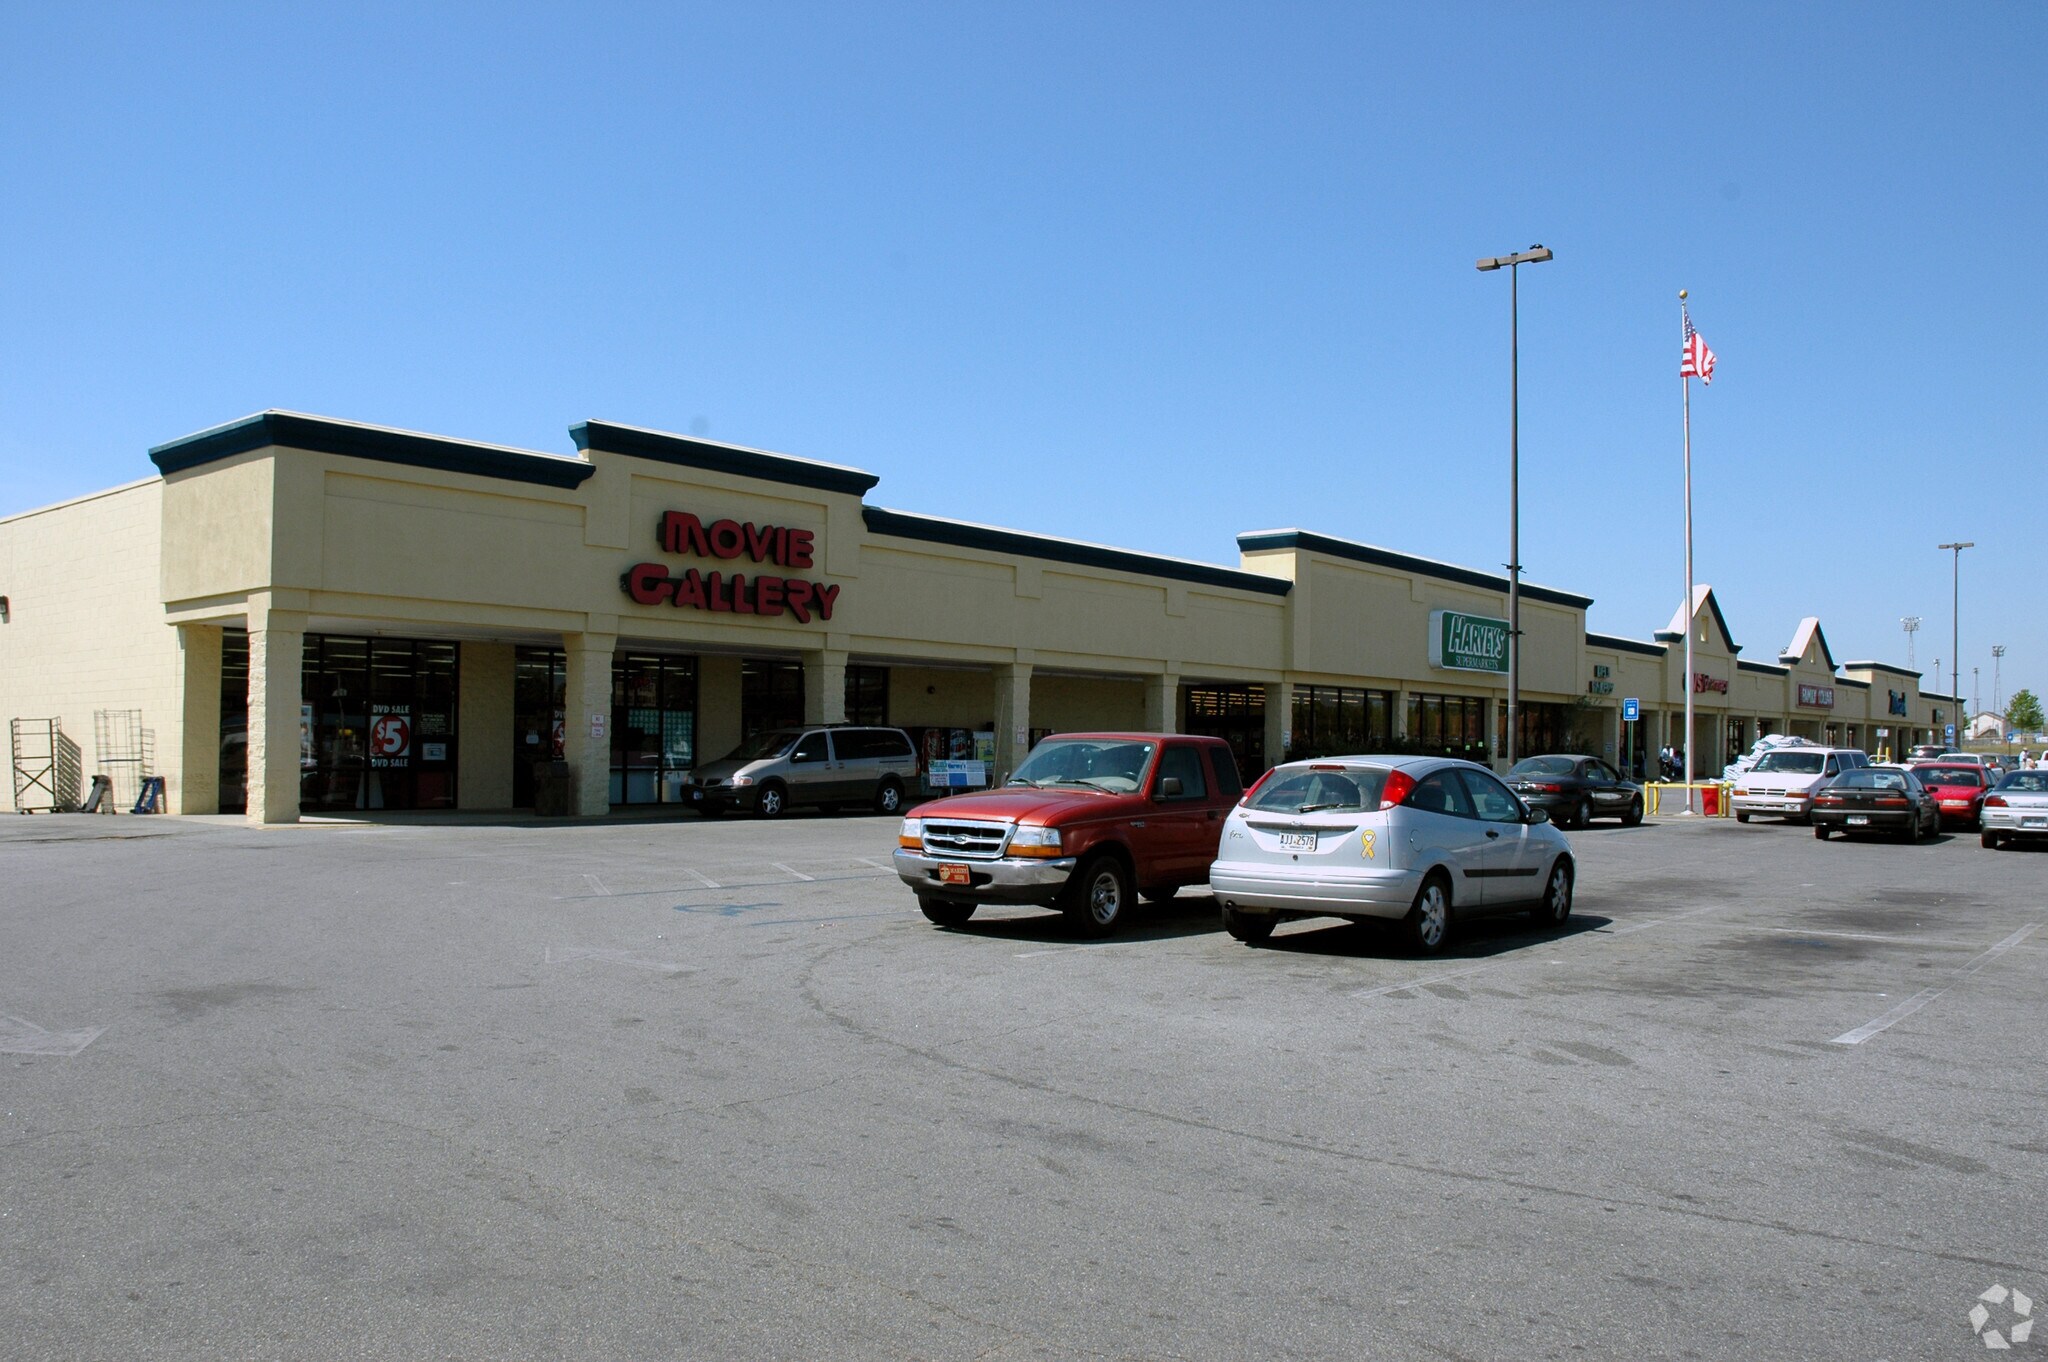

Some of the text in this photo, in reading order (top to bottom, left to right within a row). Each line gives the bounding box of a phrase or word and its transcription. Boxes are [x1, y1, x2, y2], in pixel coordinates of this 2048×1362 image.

[663, 510, 815, 569] MOVIE
[629, 562, 841, 624] GALLERY
[1448, 615, 1506, 659] HARVEYS
[1455, 655, 1499, 670] SUPERMARKETS
[373, 704, 410, 714] DVD SALE
[377, 721, 402, 753] $5
[371, 758, 408, 767] DVD SALE
[1280, 834, 1293, 844] AJJ
[1296, 835, 1315, 846] 2578
